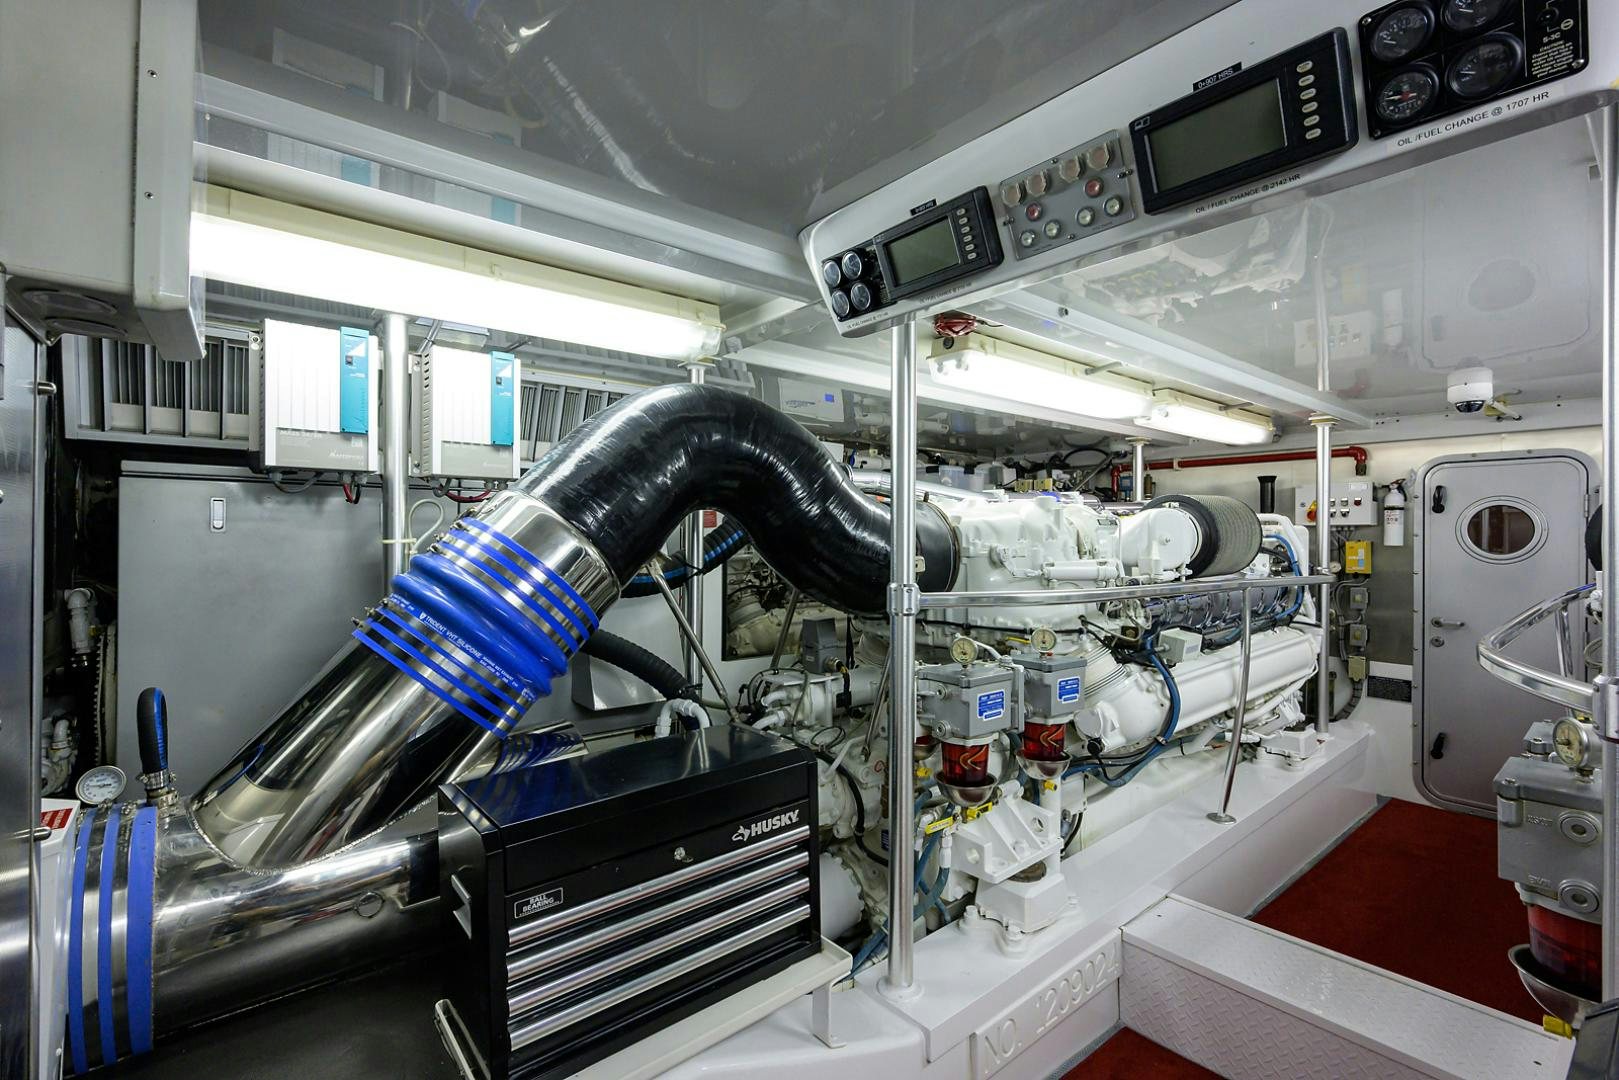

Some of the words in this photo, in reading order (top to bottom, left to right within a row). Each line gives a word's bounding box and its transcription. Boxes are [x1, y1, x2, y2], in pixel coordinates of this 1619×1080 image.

[1397, 136, 1412, 147] OIL
[1445, 112, 1489, 132] CHANGE
[1491, 106, 1503, 117] @
[1507, 97, 1529, 111] 1707
[1533, 91, 1550, 103] HR
[1230, 188, 1259, 202] CHANGE
[1288, 173, 1301, 183] HR
[425, 616, 446, 632] TRIDENT
[446, 629, 458, 641] VHT
[457, 638, 482, 658] SILICONE
[751, 809, 799, 837] HUSKY
[522, 897, 554, 912] BEARING
[530, 894, 547, 905] BALL
